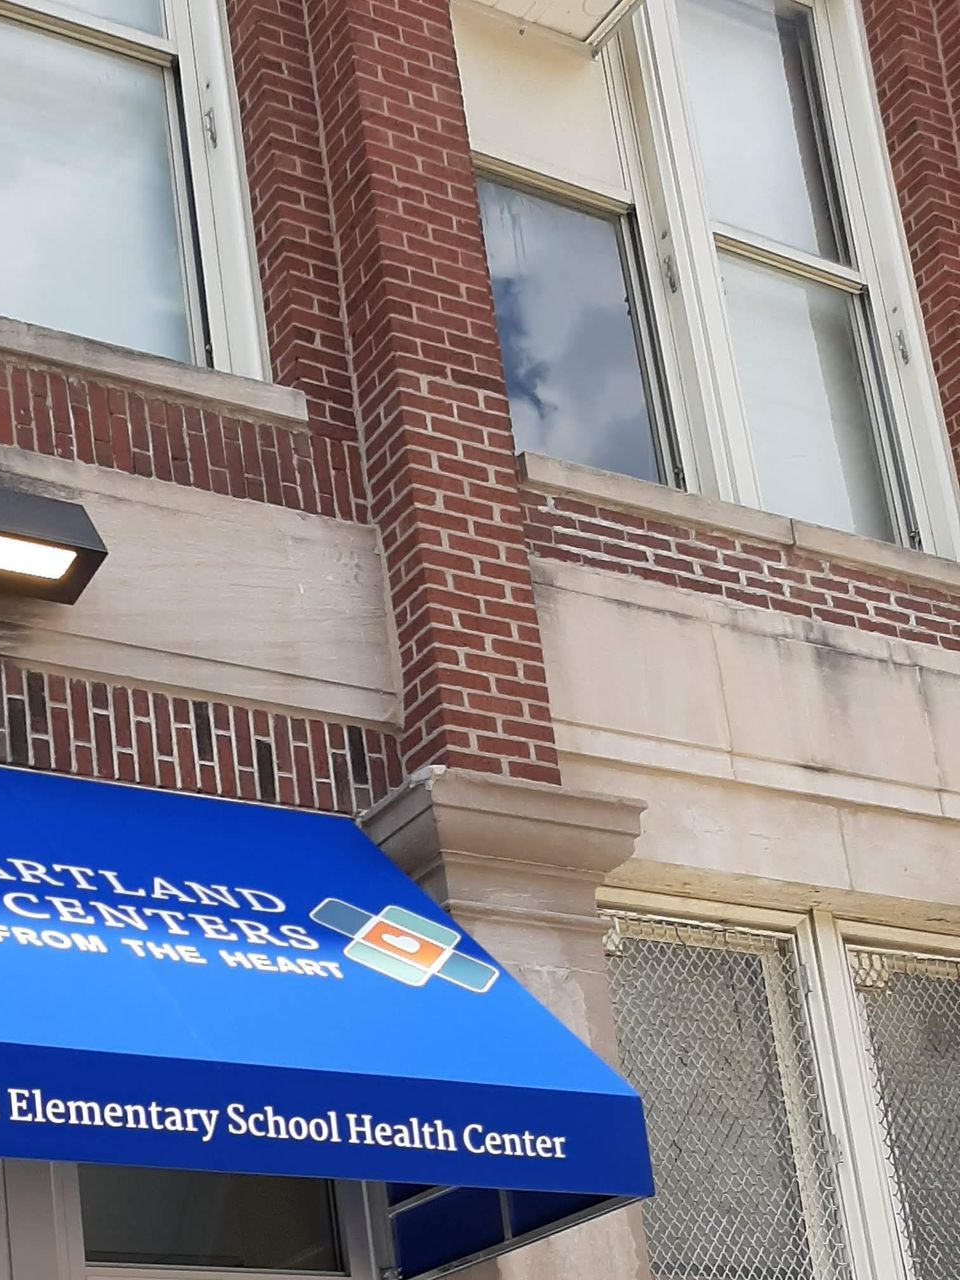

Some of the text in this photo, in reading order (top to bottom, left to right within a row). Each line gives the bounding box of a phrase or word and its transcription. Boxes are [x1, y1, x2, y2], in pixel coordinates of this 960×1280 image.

[3, 892, 320, 950] CENTERS
[121, 938, 208, 964] THE
[219, 950, 344, 978] HEART
[8, 1088, 219, 1141] Elementary
[226, 1103, 341, 1143] School
[346, 1113, 457, 1152] Health
[463, 1124, 566, 1158] Center
